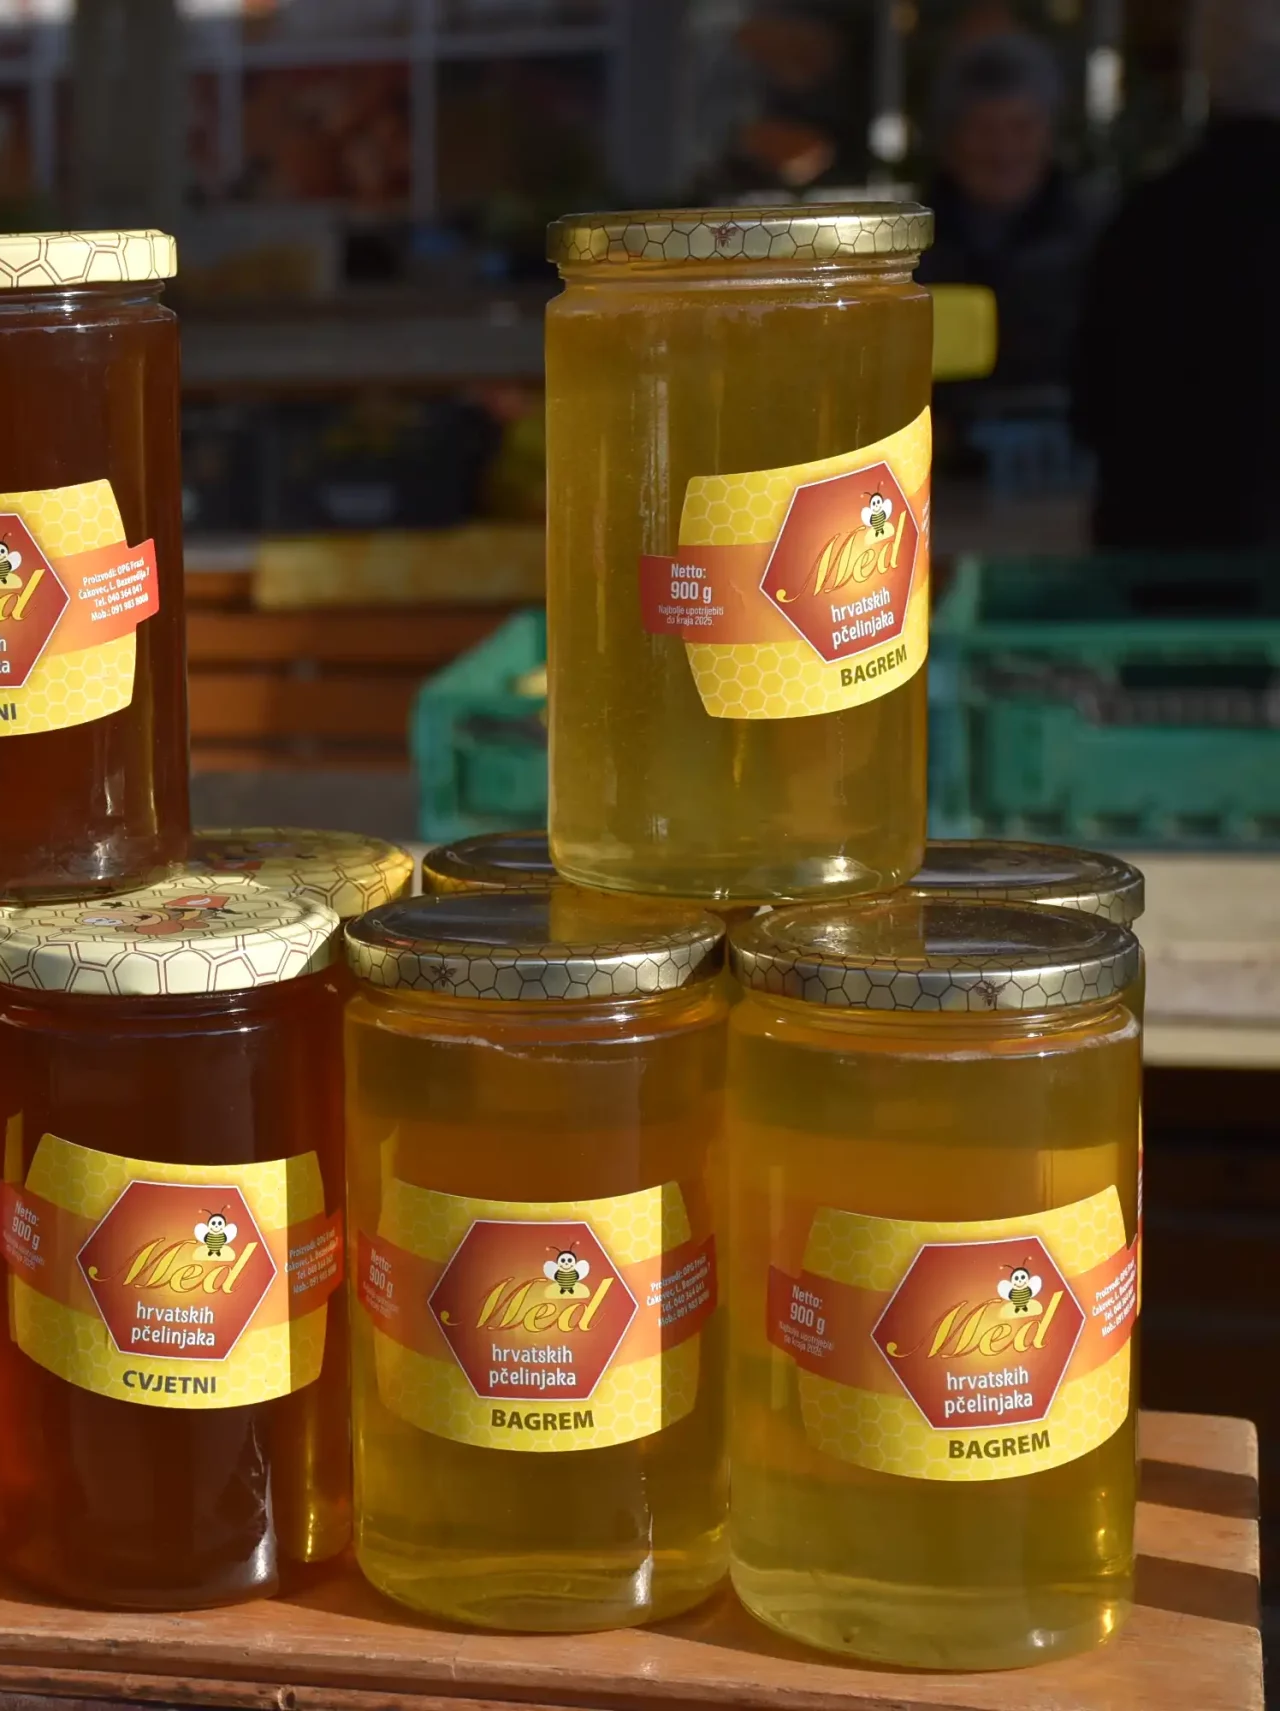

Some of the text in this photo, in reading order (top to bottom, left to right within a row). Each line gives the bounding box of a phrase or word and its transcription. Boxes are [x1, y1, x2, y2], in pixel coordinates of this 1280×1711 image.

[775, 509, 907, 603] Med
[83, 569, 117, 586] Proizvodi:
[117, 563, 130, 574] OPG
[671, 563, 706, 579] Netto:
[94, 597, 107, 607] Tel.
[670, 581, 712, 604] 900 g
[831, 587, 891, 624] hrvatskih
[676, 616, 693, 626] kraja
[832, 610, 895, 650] pčelinjaka
[841, 644, 907, 687] BAGREM
[15, 1200, 39, 1227] Netto:
[12, 1216, 31, 1241] 900
[32, 1234, 40, 1251] g
[88, 1236, 258, 1295] Med
[370, 1264, 393, 1298] 900 g
[440, 1276, 614, 1333] Med
[792, 1284, 823, 1310] Netto:
[136, 1301, 214, 1324] hrvatskih
[790, 1302, 825, 1335] 900 g
[886, 1290, 1064, 1359] Med
[131, 1324, 215, 1349] pčelinjaka
[492, 1343, 573, 1365] hrvatskih
[121, 1369, 216, 1394] CVJETNI
[489, 1367, 577, 1391] pčelinjaka
[947, 1365, 1029, 1391] hrvatskih
[944, 1391, 1033, 1418] pčelinjaka
[491, 1408, 595, 1432] BAGREM
[948, 1430, 1051, 1459] BAGREM
